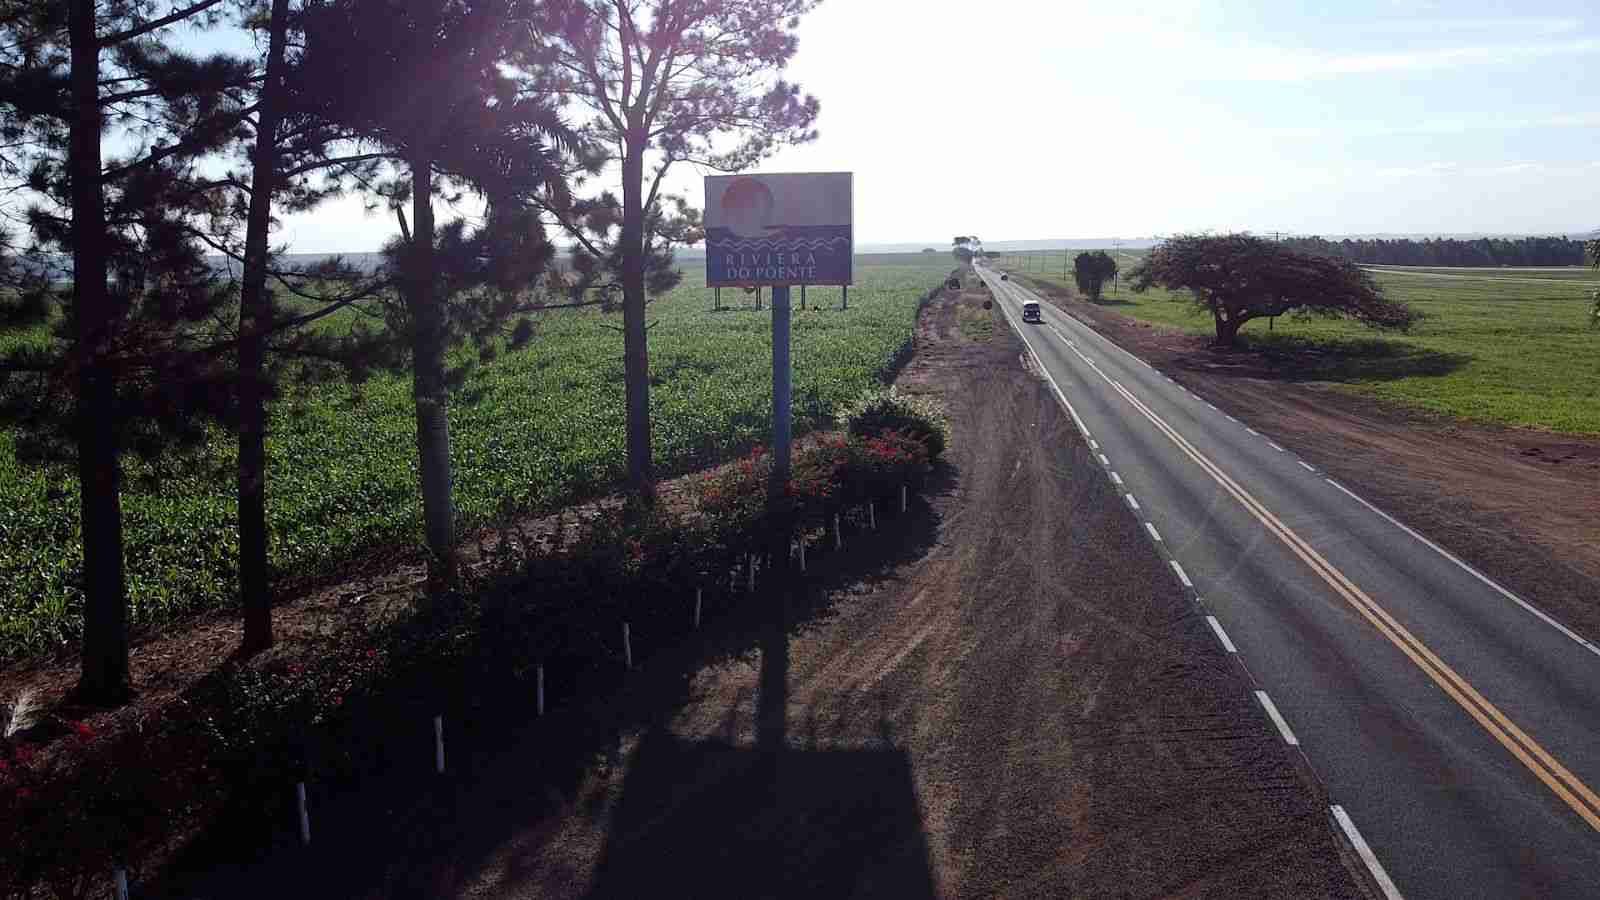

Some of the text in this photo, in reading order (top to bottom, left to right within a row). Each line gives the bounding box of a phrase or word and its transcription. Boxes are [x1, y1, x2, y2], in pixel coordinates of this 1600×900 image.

[726, 252, 817, 265] RIVIERA
[727, 266, 817, 279] DO POENTE
